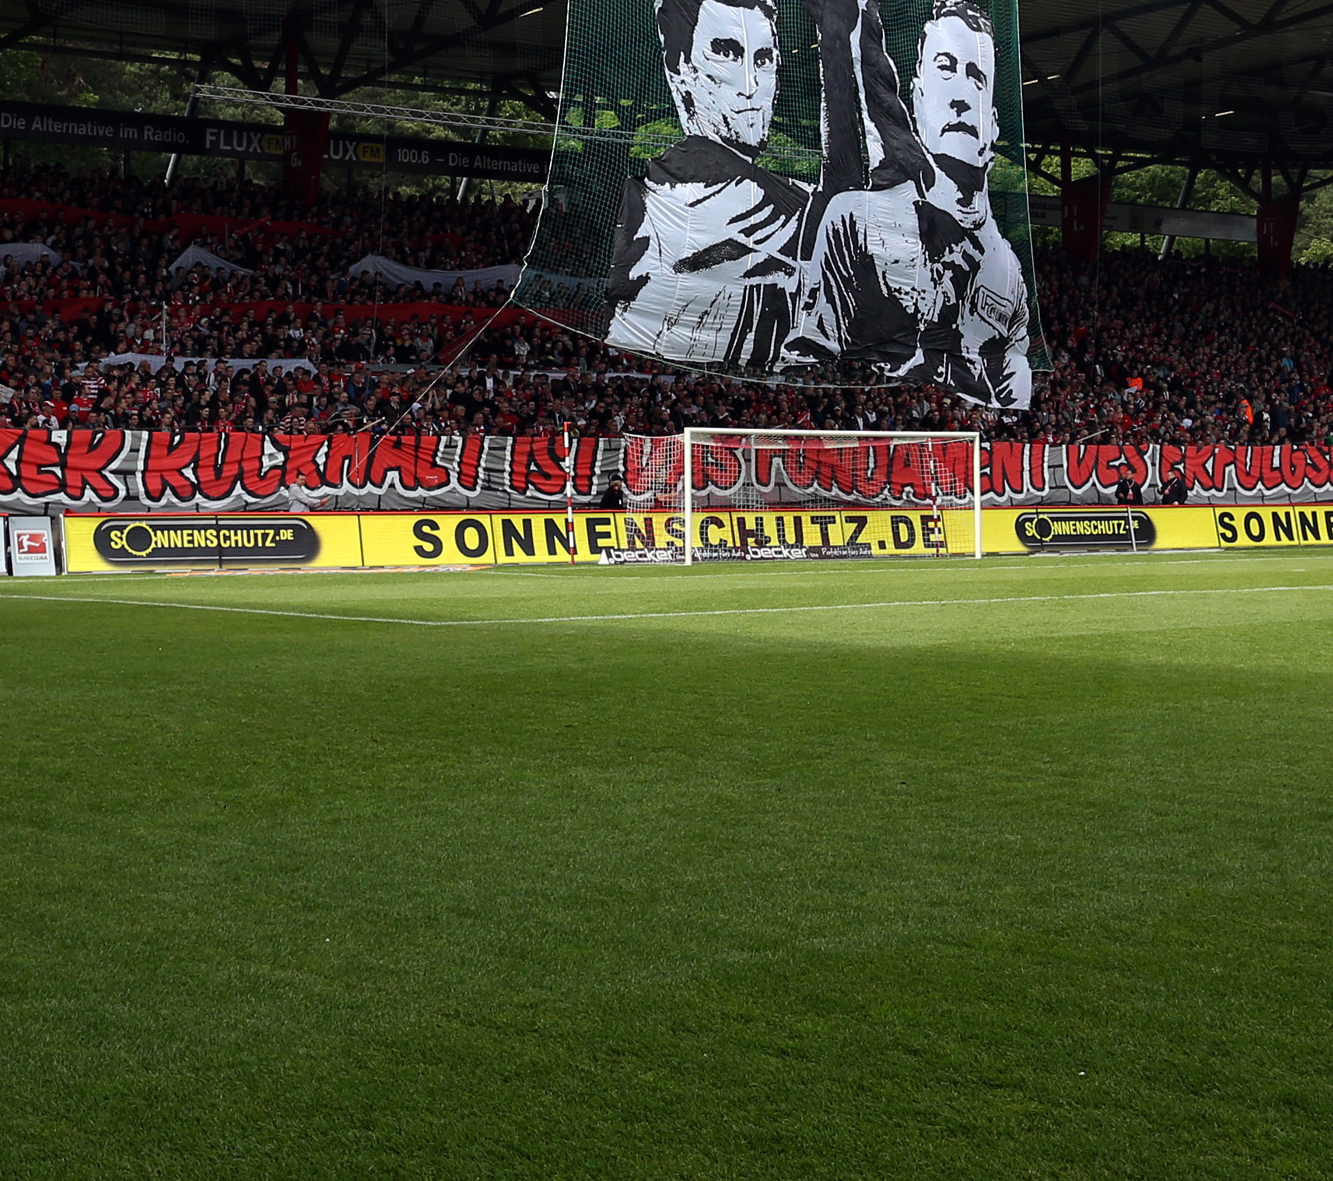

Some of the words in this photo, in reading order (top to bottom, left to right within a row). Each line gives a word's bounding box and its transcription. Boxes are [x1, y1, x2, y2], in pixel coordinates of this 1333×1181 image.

[0, 114, 26, 130] Die
[33, 117, 114, 139] Alternative
[120, 123, 138, 140] im
[143, 126, 190, 145] Radio.
[397, 147, 429, 164] 100.6
[448, 153, 470, 168] Die
[473, 155, 540, 174] Alternative
[110, 521, 294, 557] SONNENSCHUTZ.DE
[412, 514, 944, 560] SONNENSCHUTZ.DE
